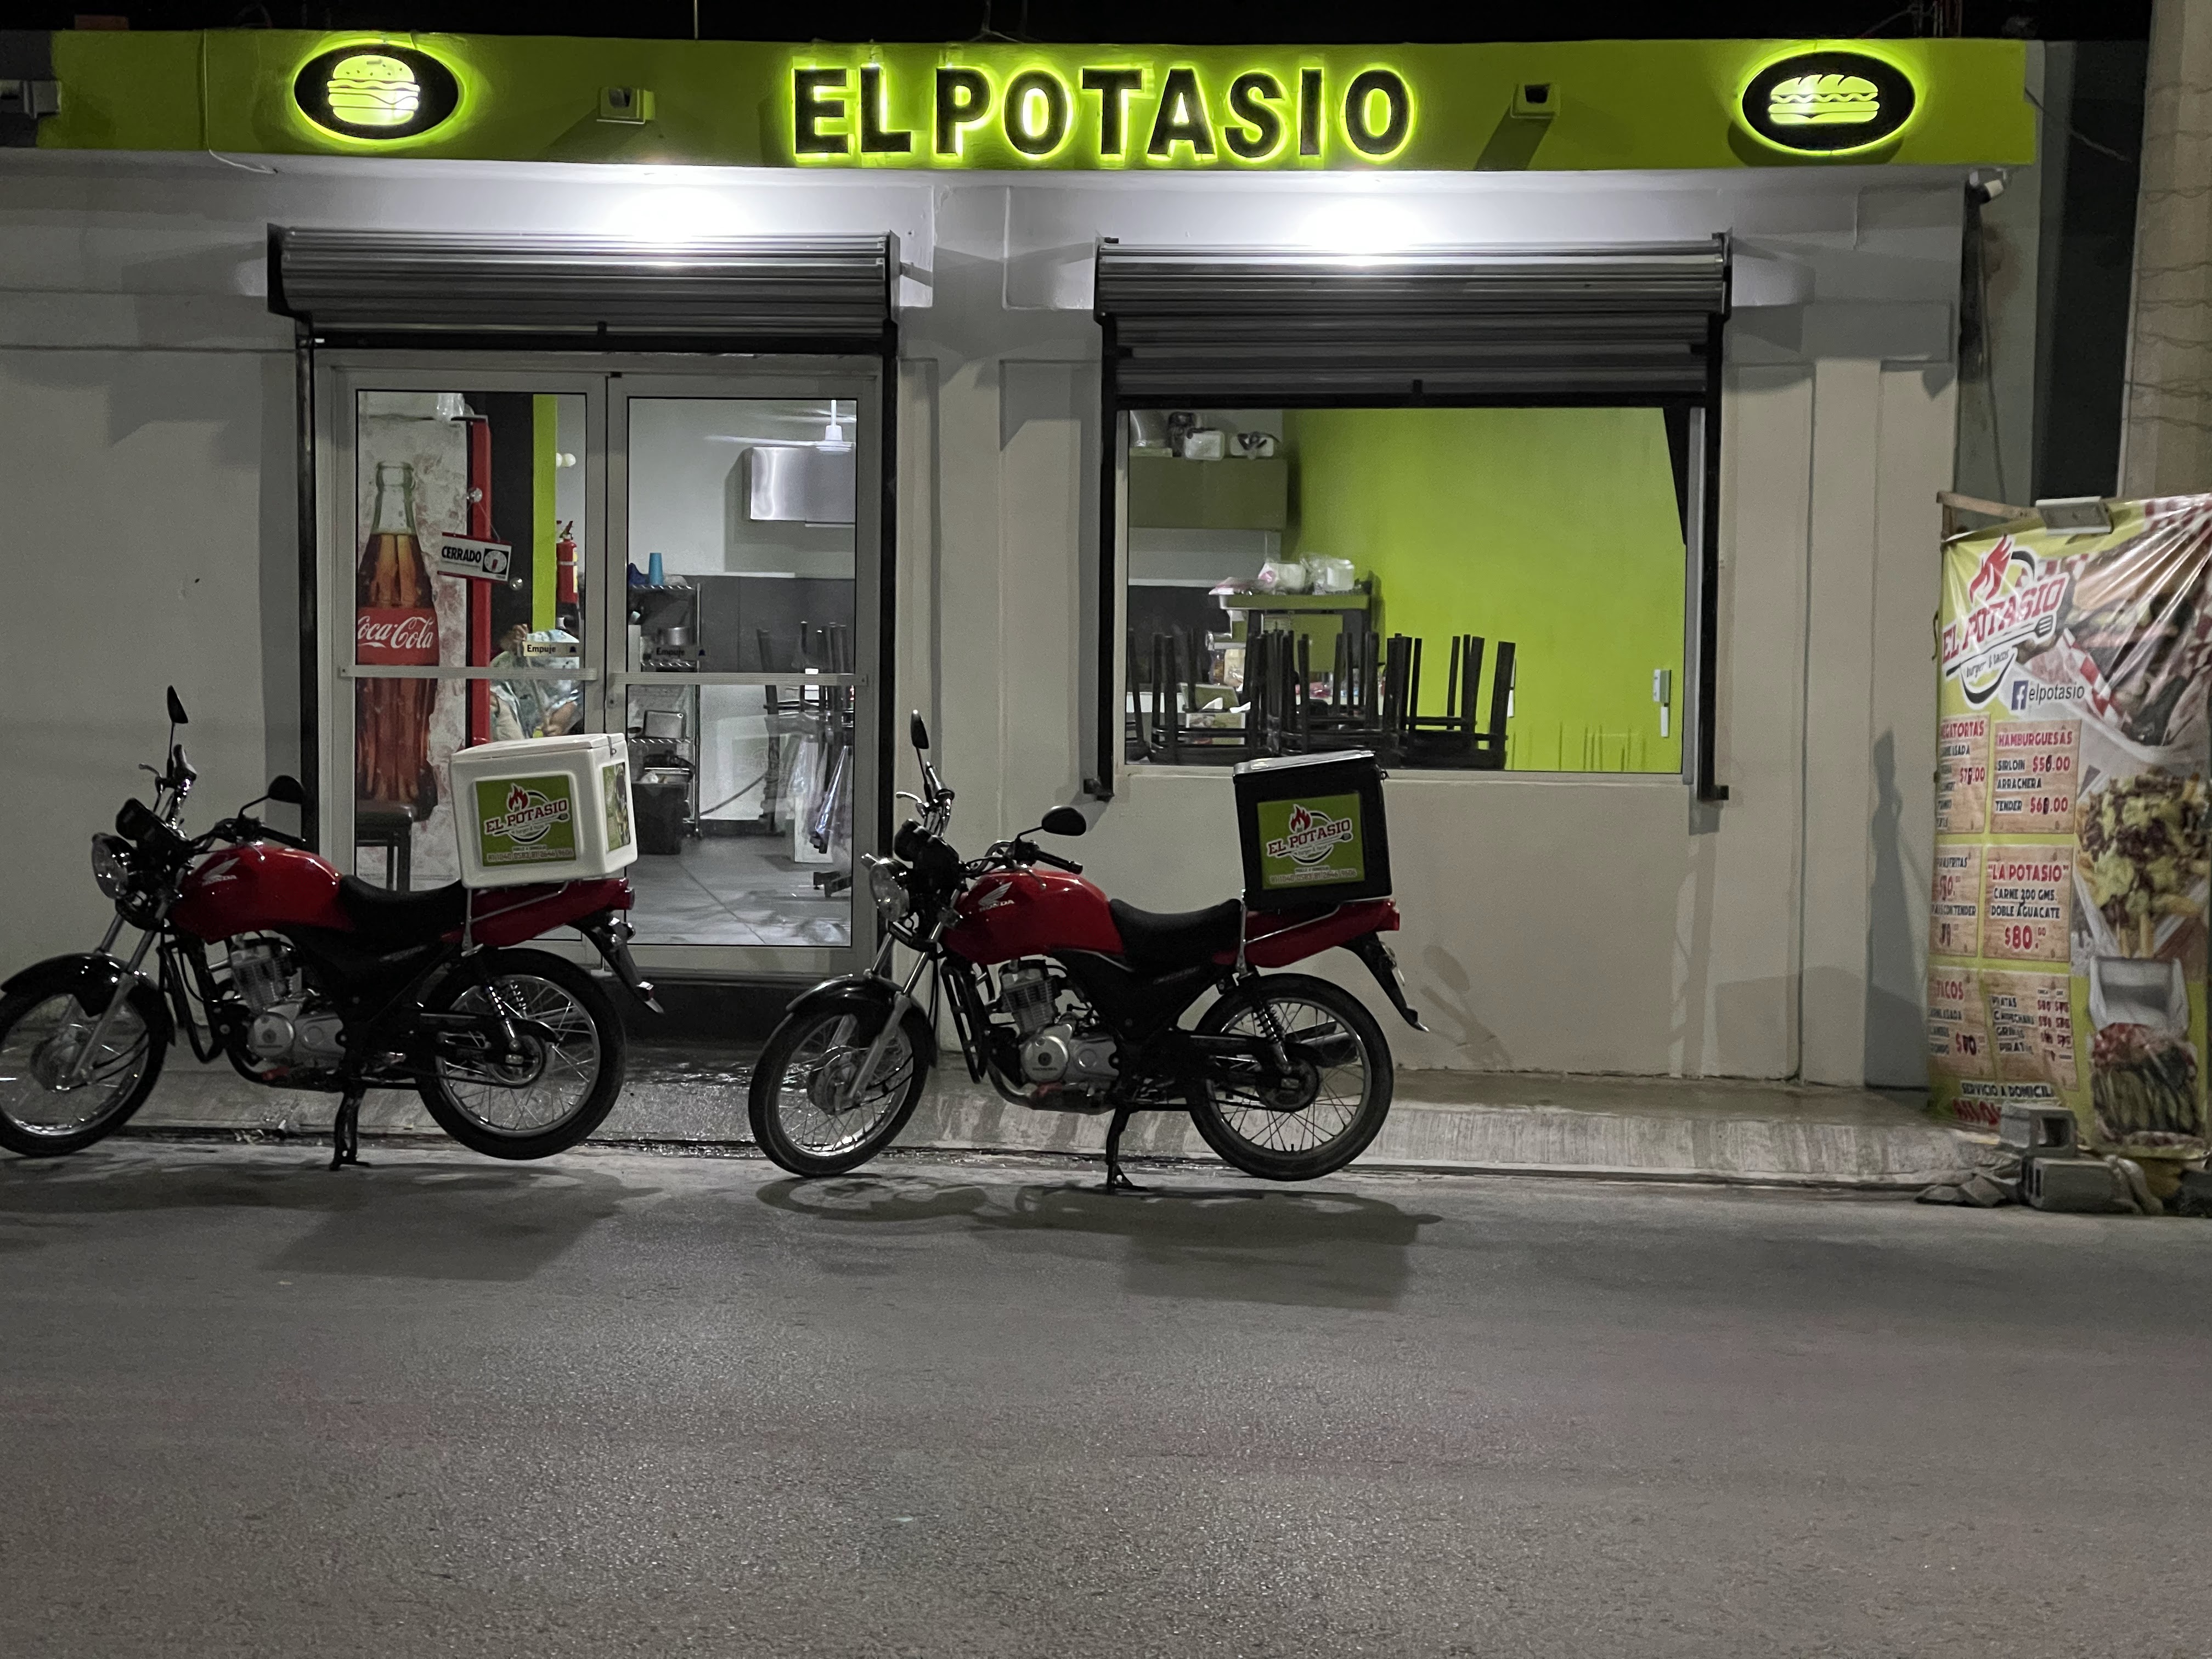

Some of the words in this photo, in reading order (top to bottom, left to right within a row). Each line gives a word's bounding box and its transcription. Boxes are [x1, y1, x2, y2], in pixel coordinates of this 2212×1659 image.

[794, 65, 912, 155] EL
[936, 67, 1410, 160] POTASIO
[441, 546, 482, 563] CERRADO
[1943, 624, 1960, 662] EL
[1962, 578, 2066, 650] POTASIO
[358, 615, 433, 649] Coca-Cola
[527, 644, 556, 655] Empuje
[656, 647, 685, 657] Empuje
[2029, 682, 2085, 706] elpotasio
[1997, 731, 2073, 747] HAMBURGUESAS
[1997, 759, 2025, 771] SIRLOIN
[1997, 777, 2042, 789] ARRACHERA
[1995, 800, 2023, 812] TENDER
[486, 820, 504, 833] EL
[507, 799, 567, 827] POTASIO
[1268, 840, 1286, 855] EL
[1289, 819, 1351, 848] POTASIO
[1994, 888, 2019, 899] CARNE
[979, 899, 1015, 912] HONDA
[1991, 905, 2015, 917] DOBLE
[1962, 1082, 1998, 1097] SERVICIO
